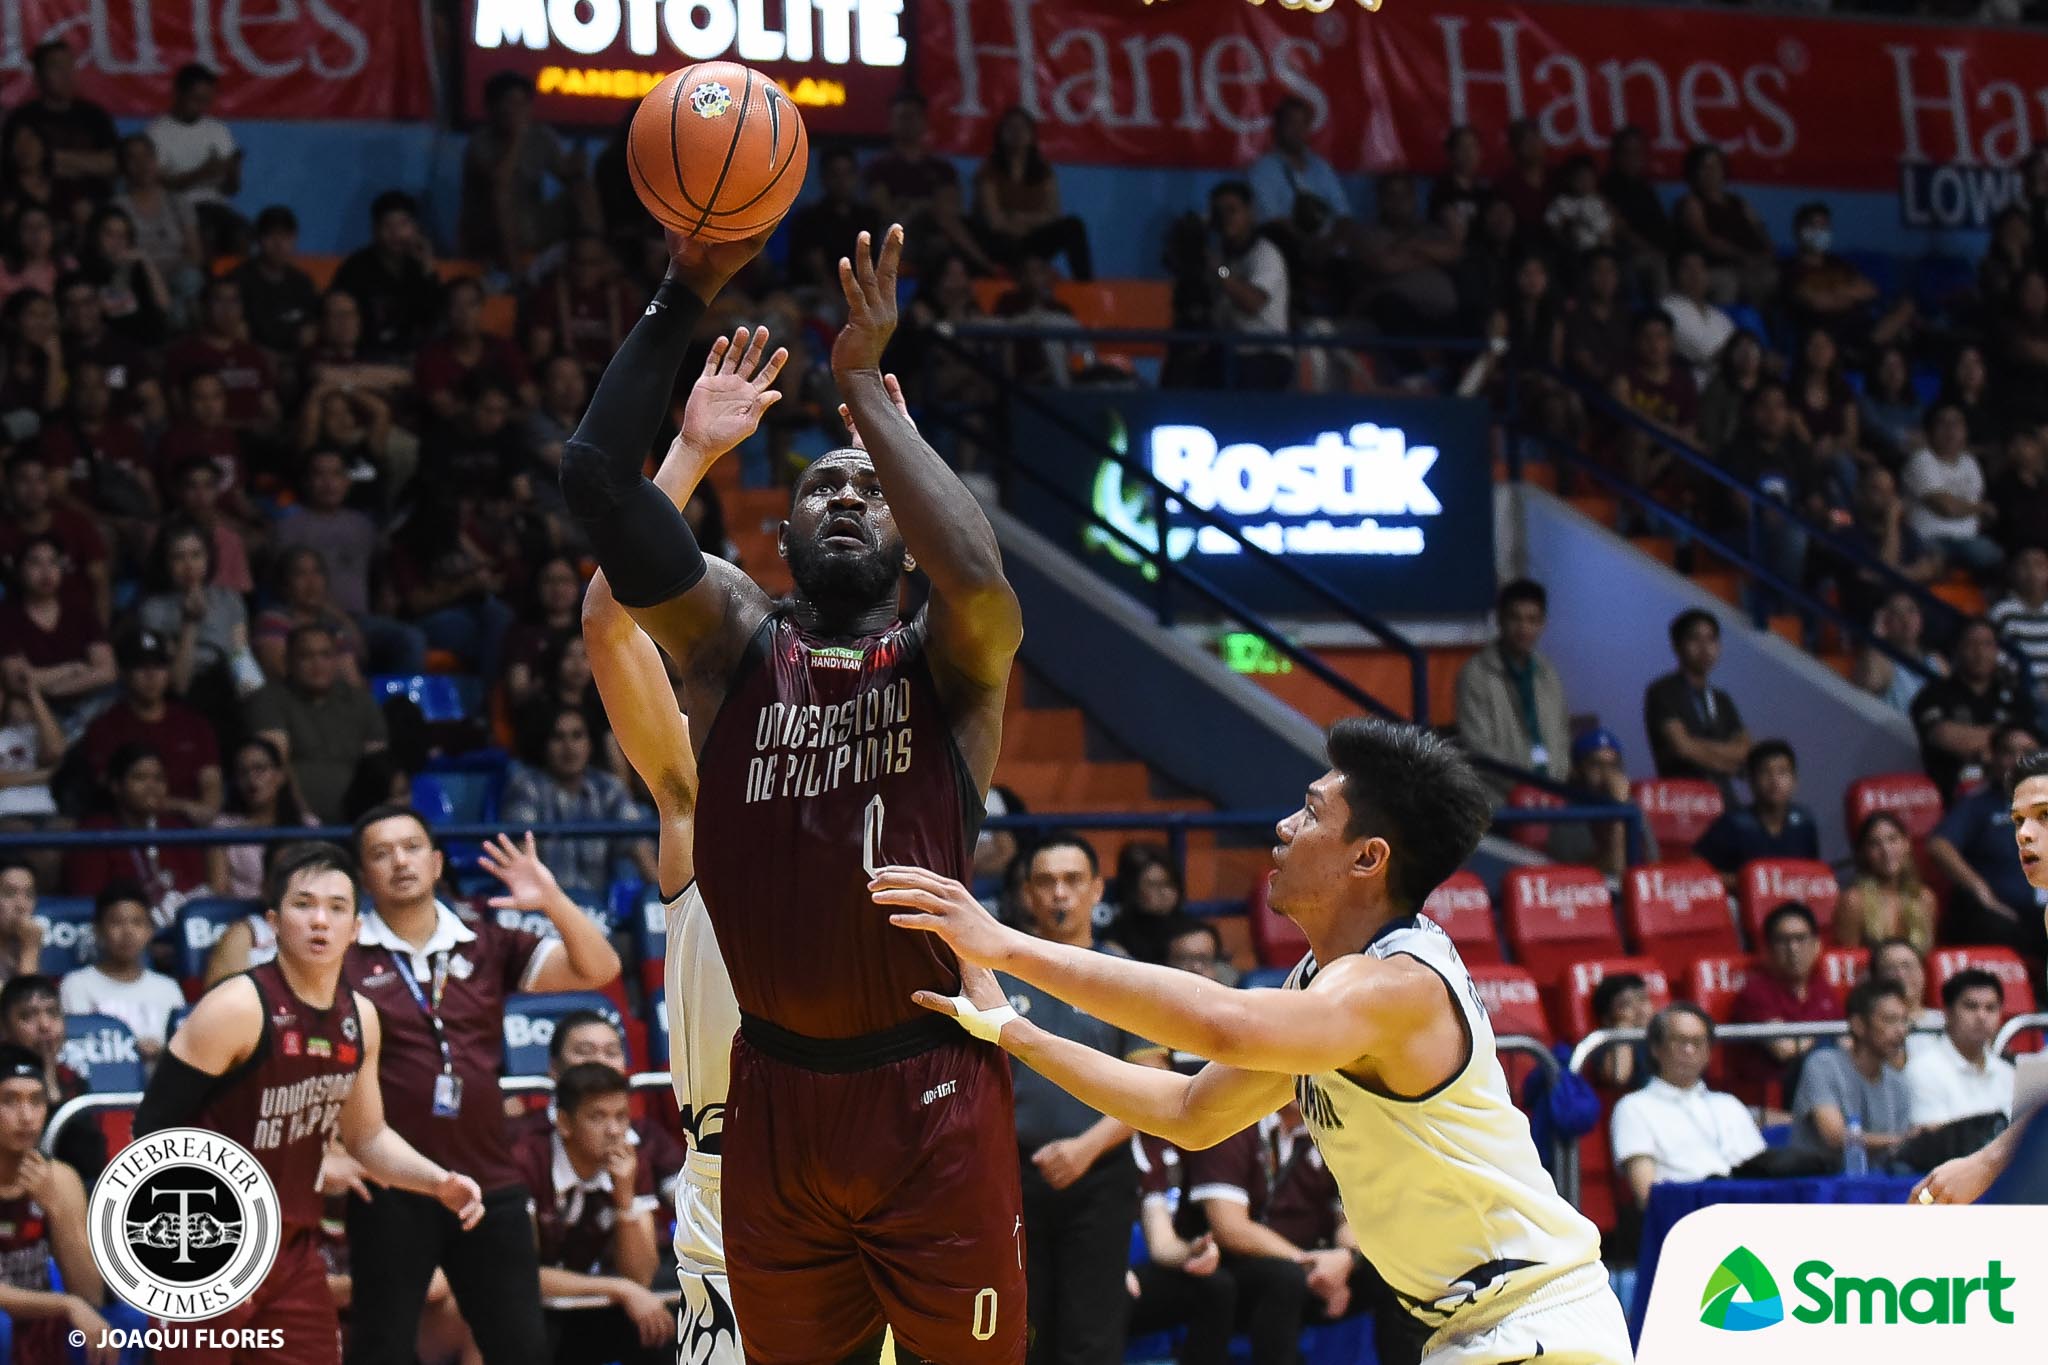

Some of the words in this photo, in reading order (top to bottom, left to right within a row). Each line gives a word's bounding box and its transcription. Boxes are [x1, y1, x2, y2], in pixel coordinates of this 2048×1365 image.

[474, 0, 907, 66] MOTOLITE
[1434, 16, 1796, 158] Hanes
[811, 656, 862, 671] HANDYMAN
[755, 677, 910, 751] UNIBERSIDAD
[746, 753, 778, 803] NG
[782, 728, 912, 797] PILIPINAS
[971, 1287, 998, 1341] 0
